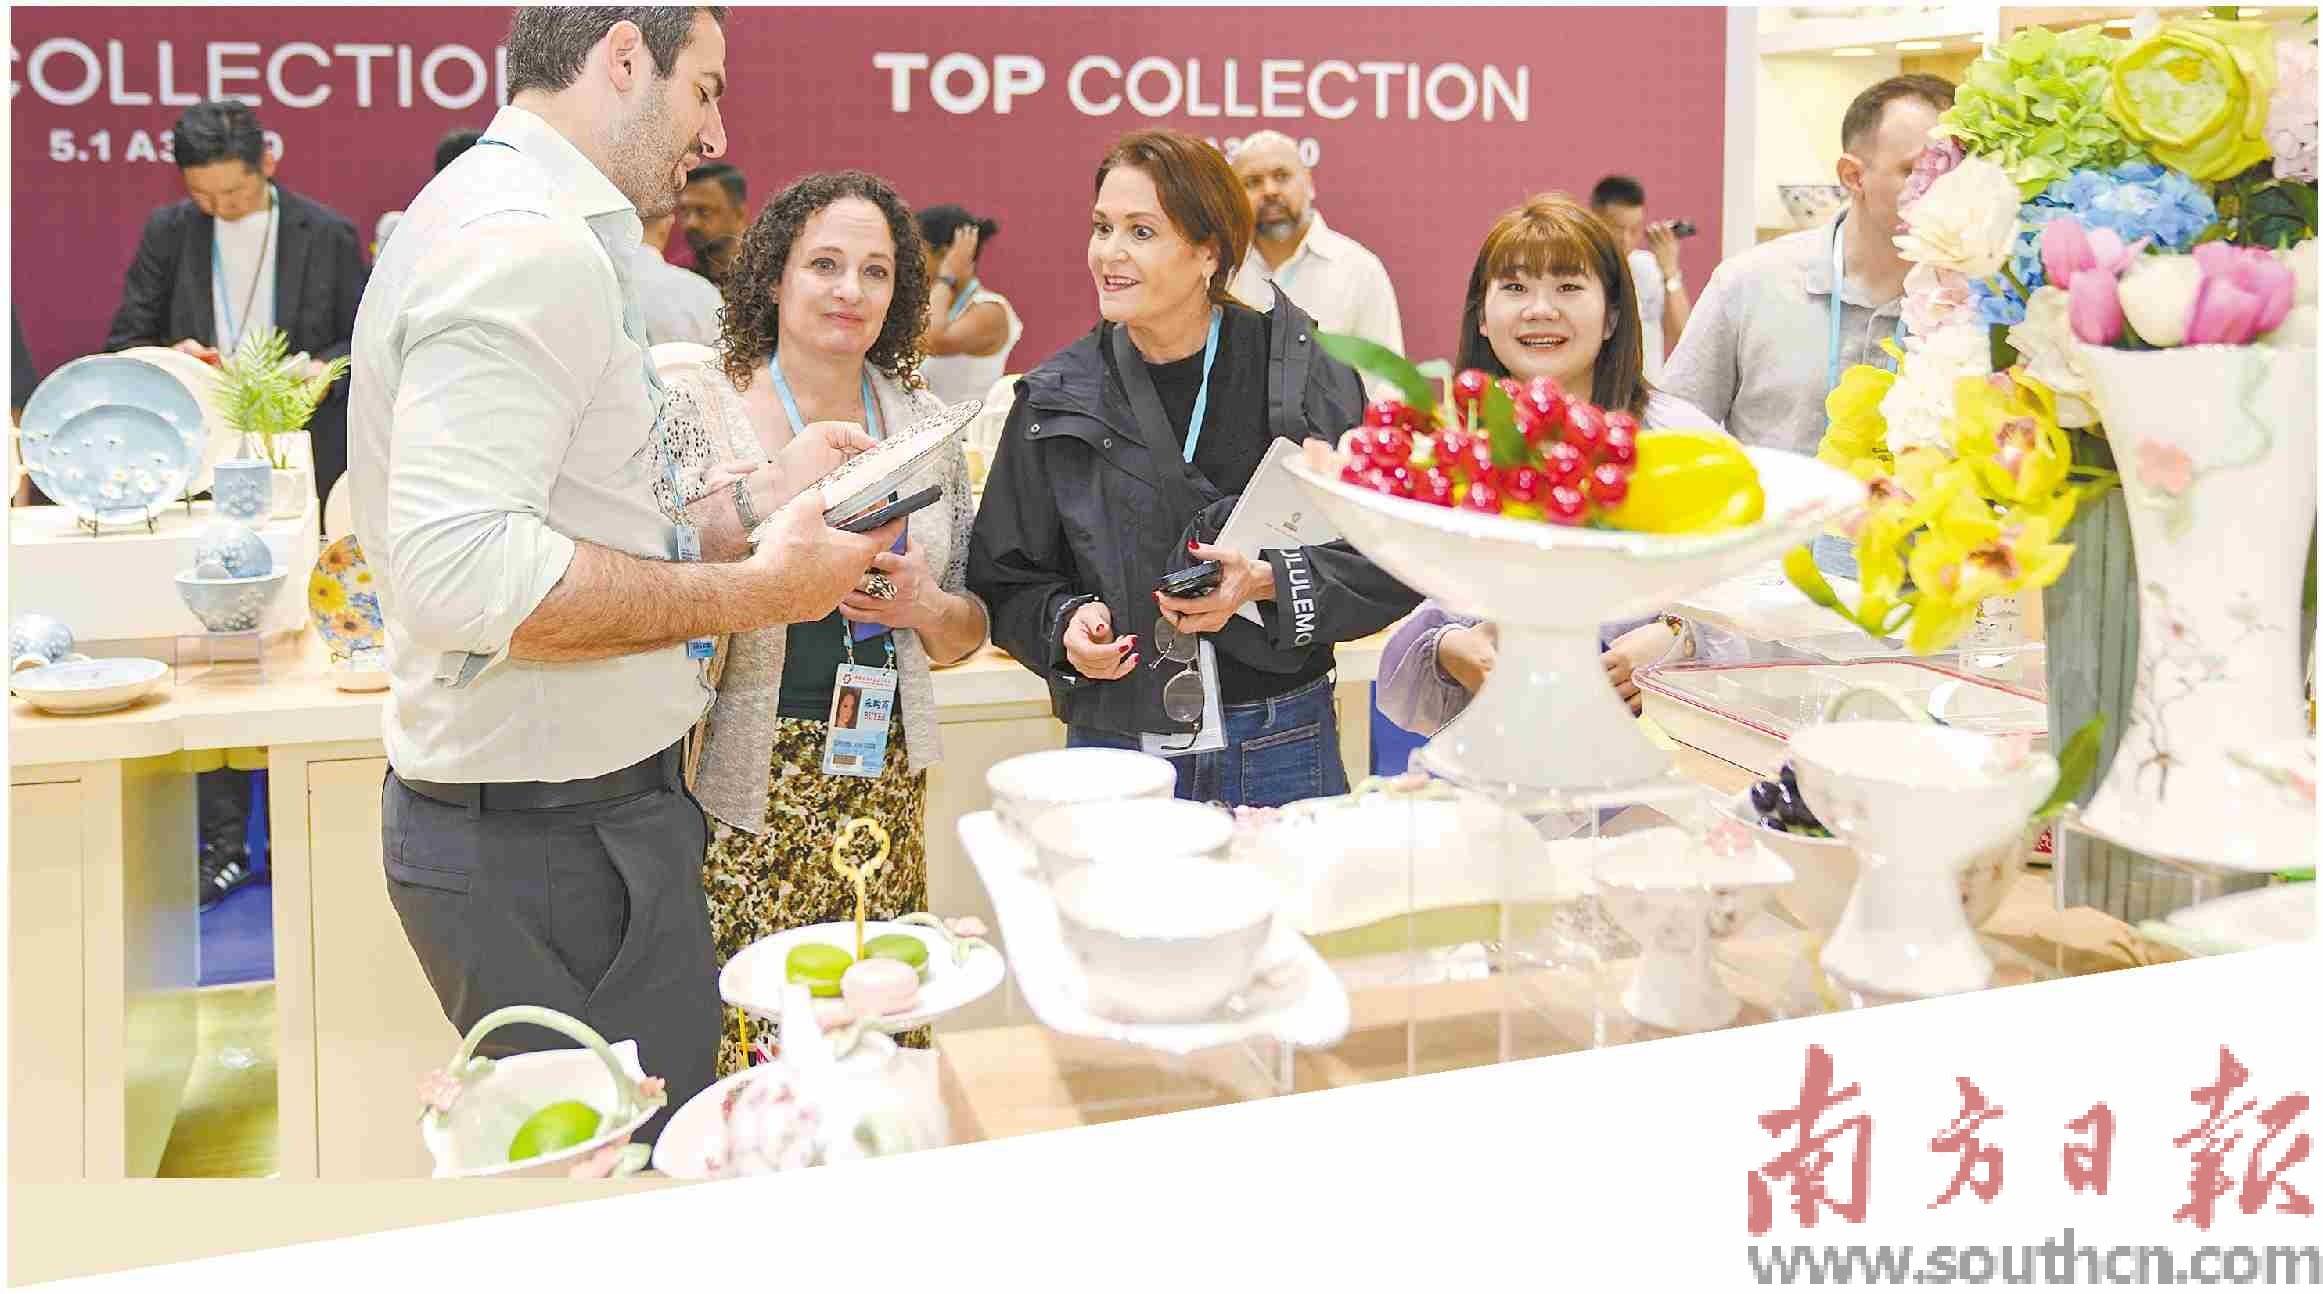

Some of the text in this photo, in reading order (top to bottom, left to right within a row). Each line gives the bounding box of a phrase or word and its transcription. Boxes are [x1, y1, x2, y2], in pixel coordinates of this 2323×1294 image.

[873, 52, 1530, 122] TOP COLLECTION
[50, 128, 111, 162] 5.1
